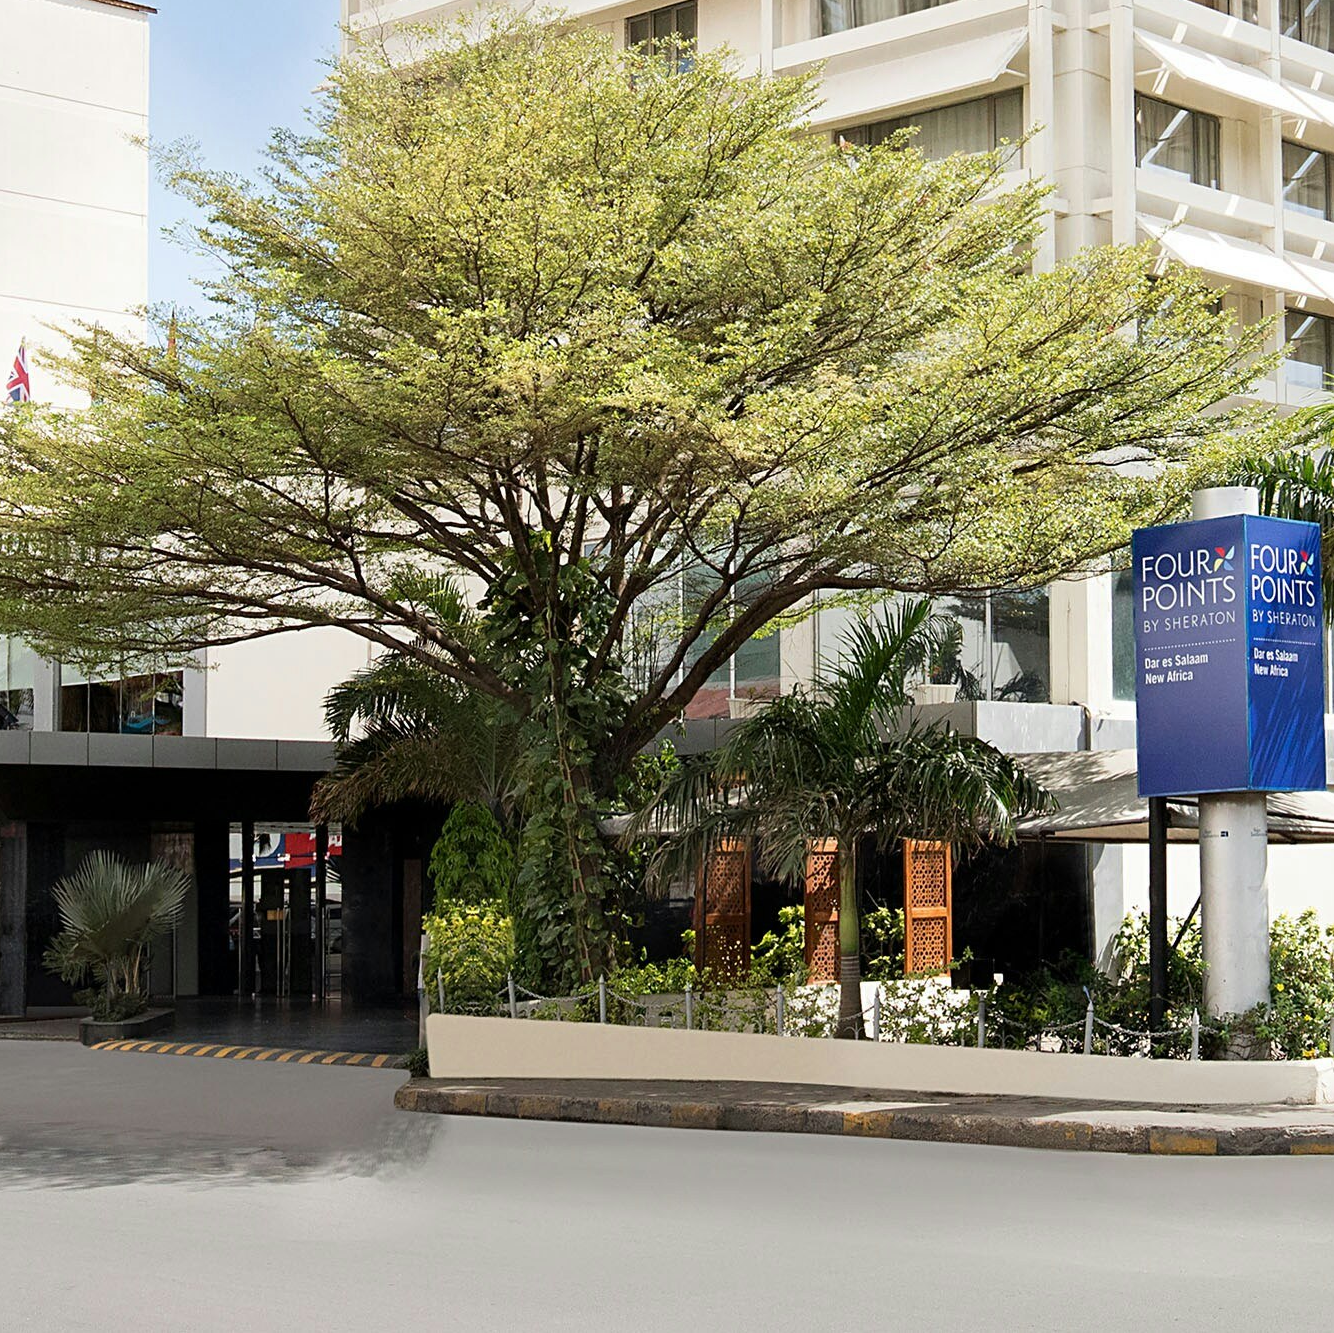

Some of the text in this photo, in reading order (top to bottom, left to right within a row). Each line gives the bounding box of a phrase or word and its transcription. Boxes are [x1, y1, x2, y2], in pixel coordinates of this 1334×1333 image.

[1142, 549, 1213, 583] FOUR
[1250, 543, 1300, 576] FOUR
[1143, 575, 1236, 613] POINTS
[1251, 574, 1316, 607] POINTS
[1143, 610, 1236, 634] BY SHERATON
[1252, 608, 1316, 628] BY SHERATON
[1144, 653, 1209, 670] Dar es Salaam
[1253, 647, 1299, 663] Dar es Salaam
[1145, 669, 1194, 685] New Africa
[1254, 663, 1289, 677] New Africa
